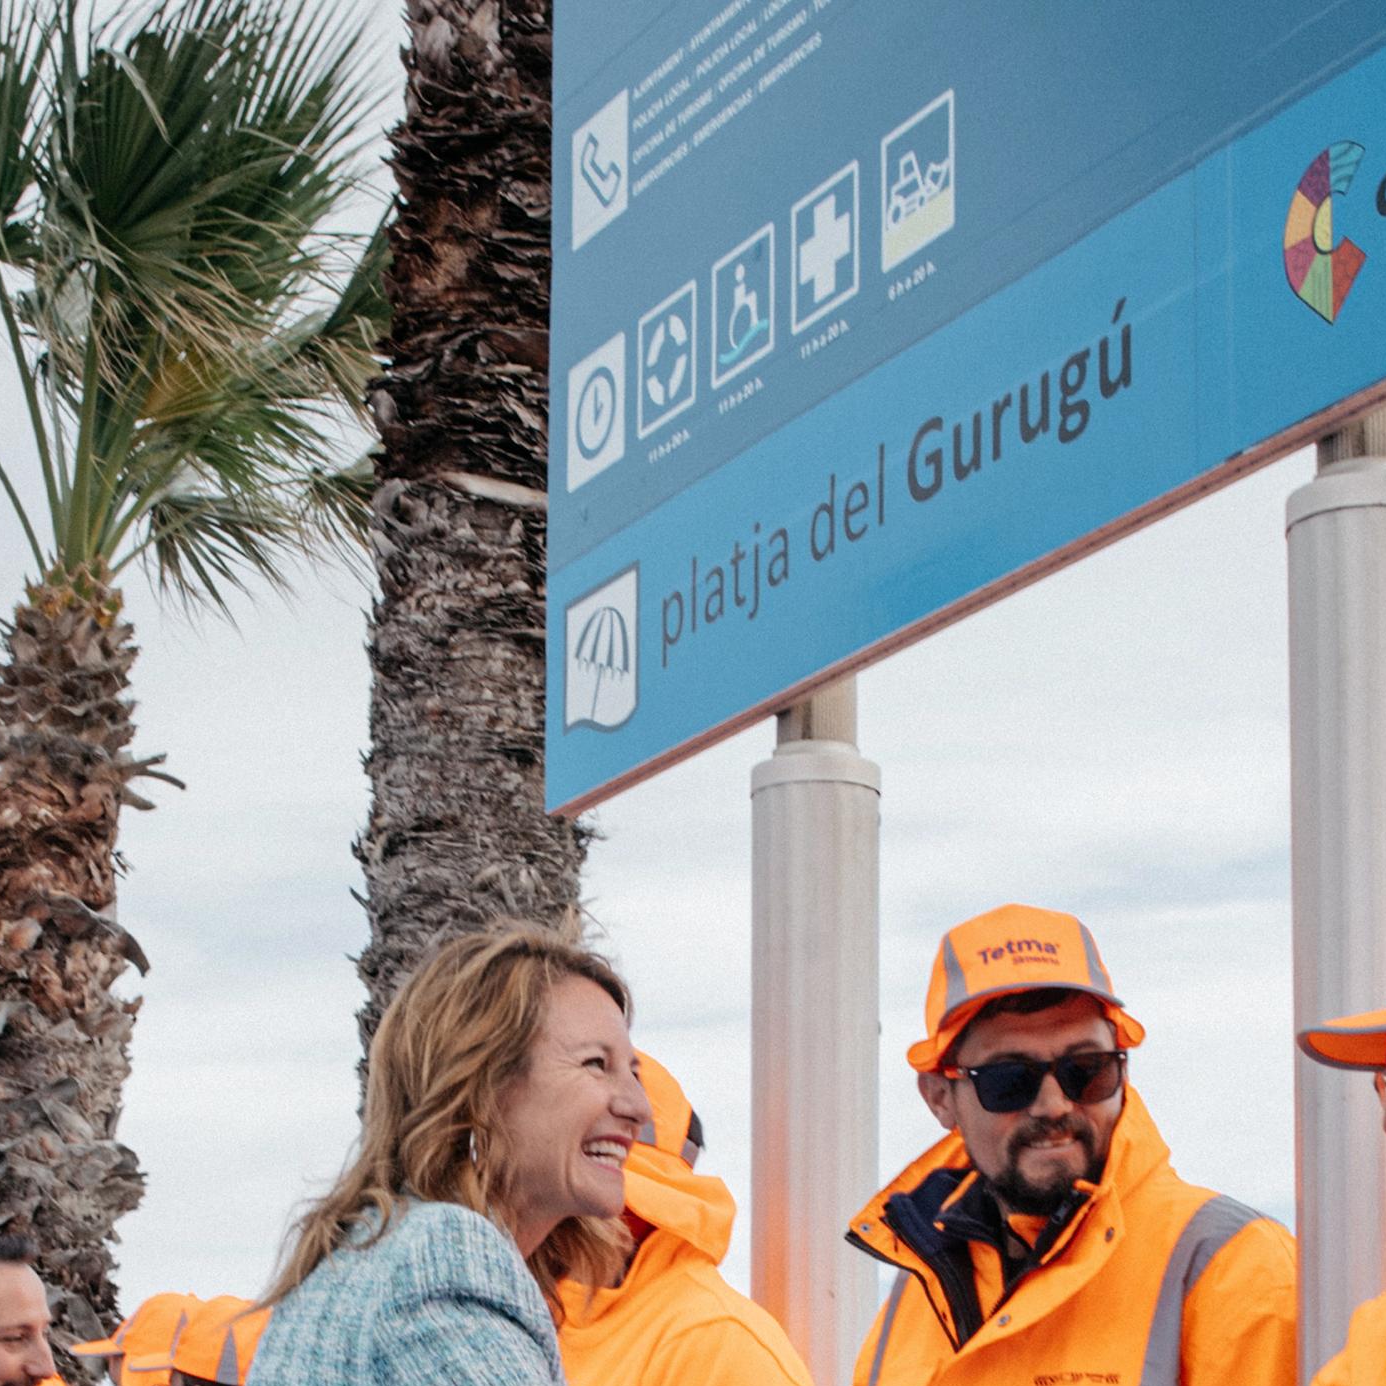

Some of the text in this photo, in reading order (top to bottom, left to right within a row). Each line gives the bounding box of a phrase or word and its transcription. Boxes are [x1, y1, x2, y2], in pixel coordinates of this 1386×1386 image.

[661, 297, 1133, 668] platja del Gurugú
